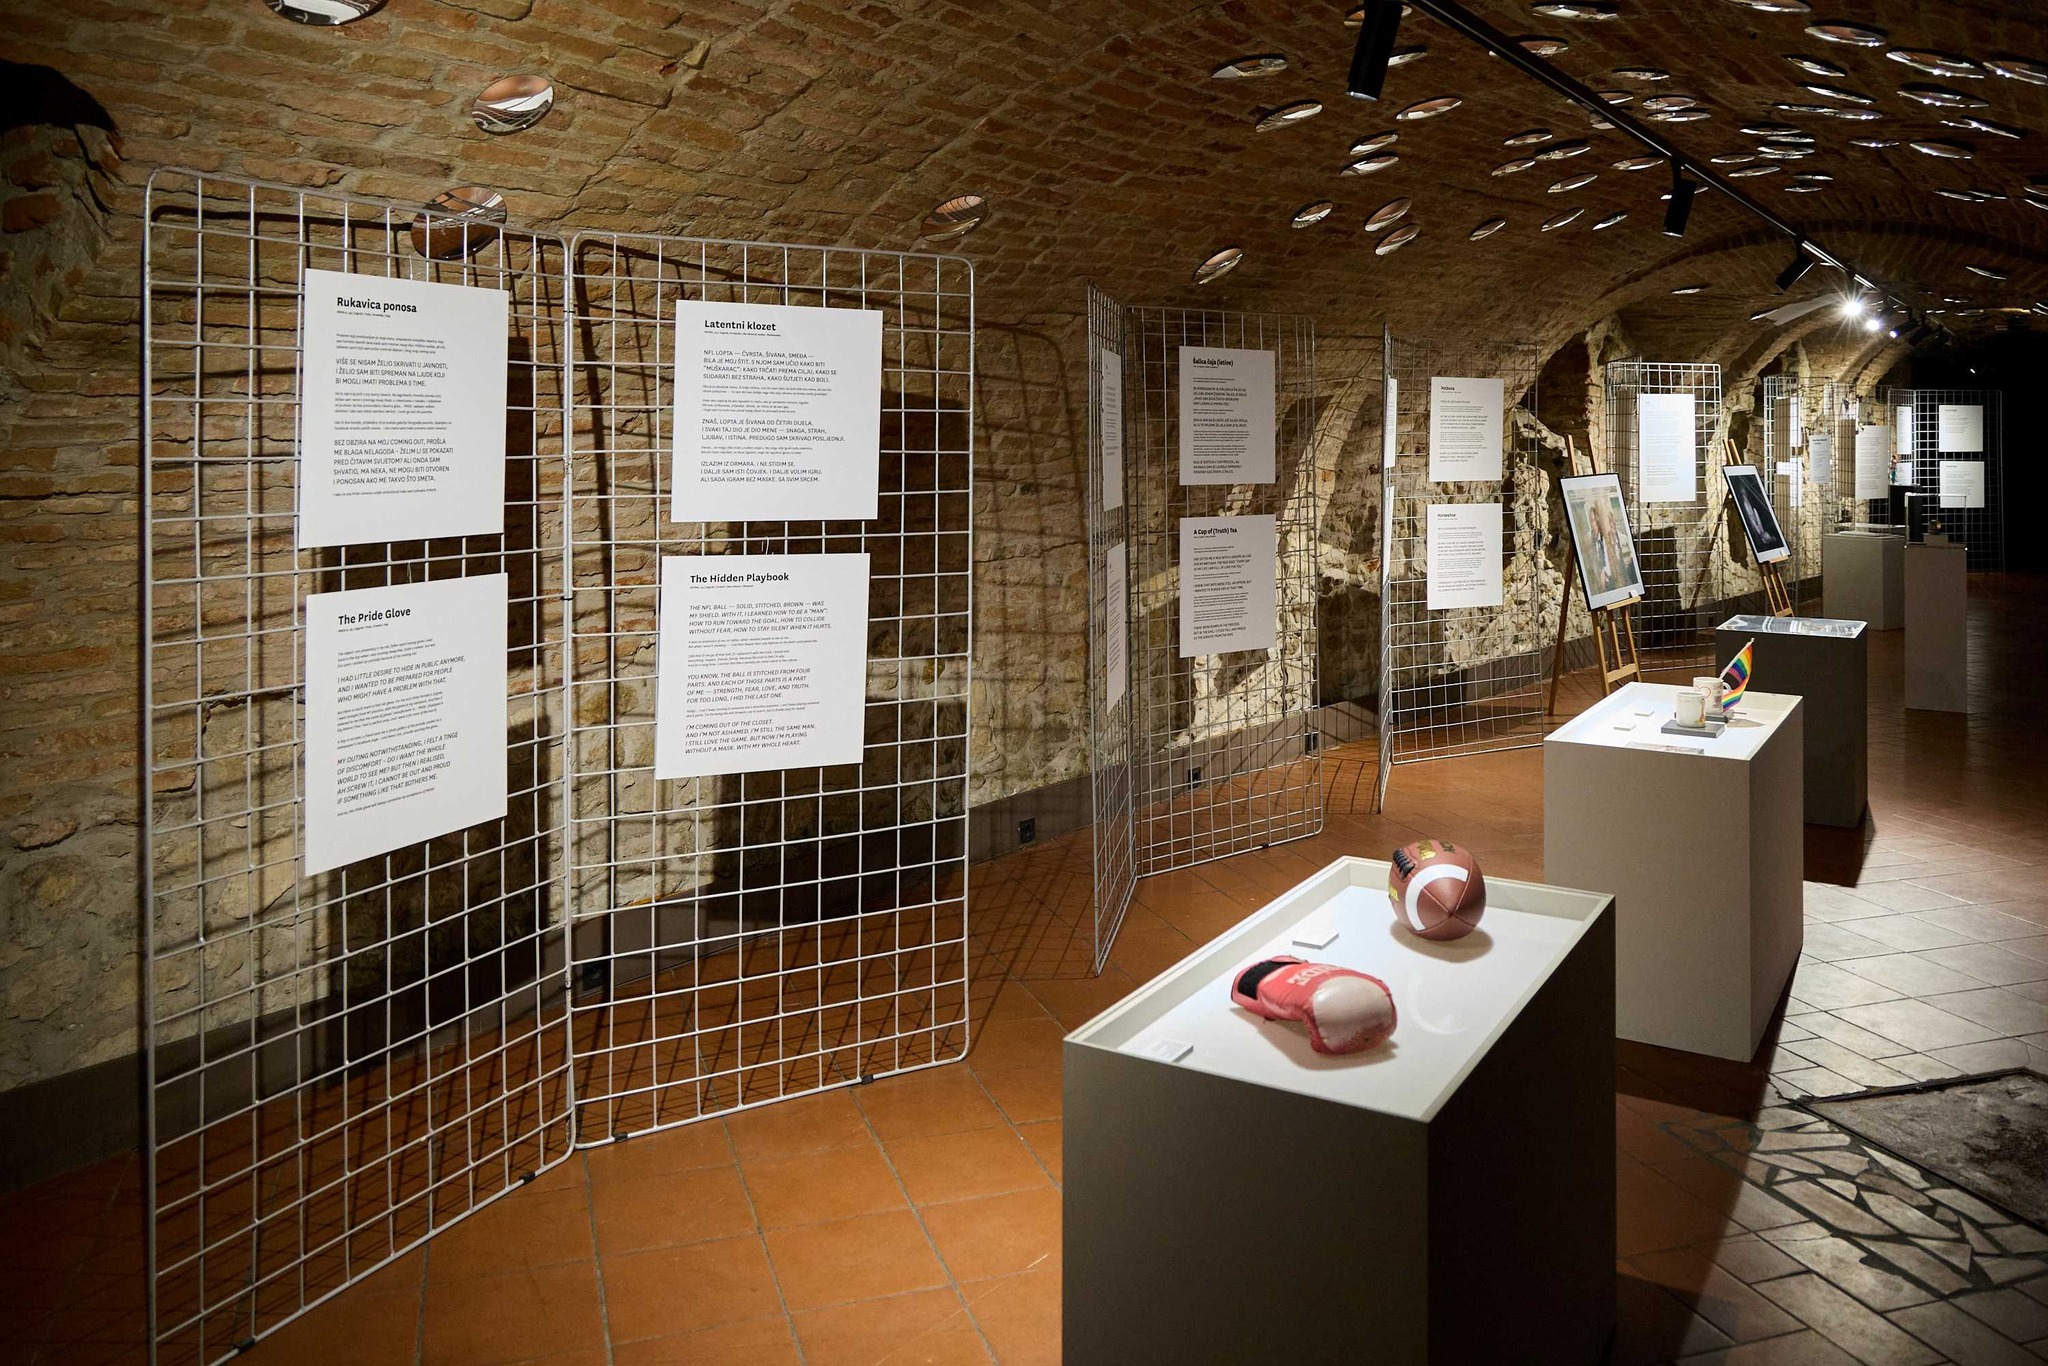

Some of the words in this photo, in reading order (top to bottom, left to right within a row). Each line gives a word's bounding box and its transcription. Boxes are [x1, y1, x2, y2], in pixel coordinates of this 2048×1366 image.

[337, 297, 381, 310] Rukavica
[383, 303, 417, 313] ponosa
[705, 320, 745, 329] Latentni
[747, 321, 776, 331] klozet
[691, 575, 707, 583] The
[710, 574, 744, 582] Hidden
[746, 572, 789, 583] Playbook
[338, 615, 356, 625] The
[358, 610, 383, 622] Pride
[385, 609, 411, 619] Glove
[355, 680, 379, 690] WANTED
[396, 672, 422, 682] PREPARED
[434, 667, 452, 675] PEOPLE
[338, 695, 352, 703] WHO
[353, 691, 371, 700] MIGHT
[372, 688, 387, 696] HAVE
[393, 683, 417, 692] PROBLEM
[347, 753, 369, 763] OUTING
[444, 732, 458, 740] TINGE
[337, 774, 359, 785] WORLD
[368, 770, 378, 778] SEE
[390, 764, 401, 772] BUT
[402, 760, 416, 768] THEN
[343, 789, 376, 803] SOMETHING
[378, 786, 389, 794] LIKE
[390, 782, 404, 790] THAT
[404, 776, 428, 787] BOTHERS
